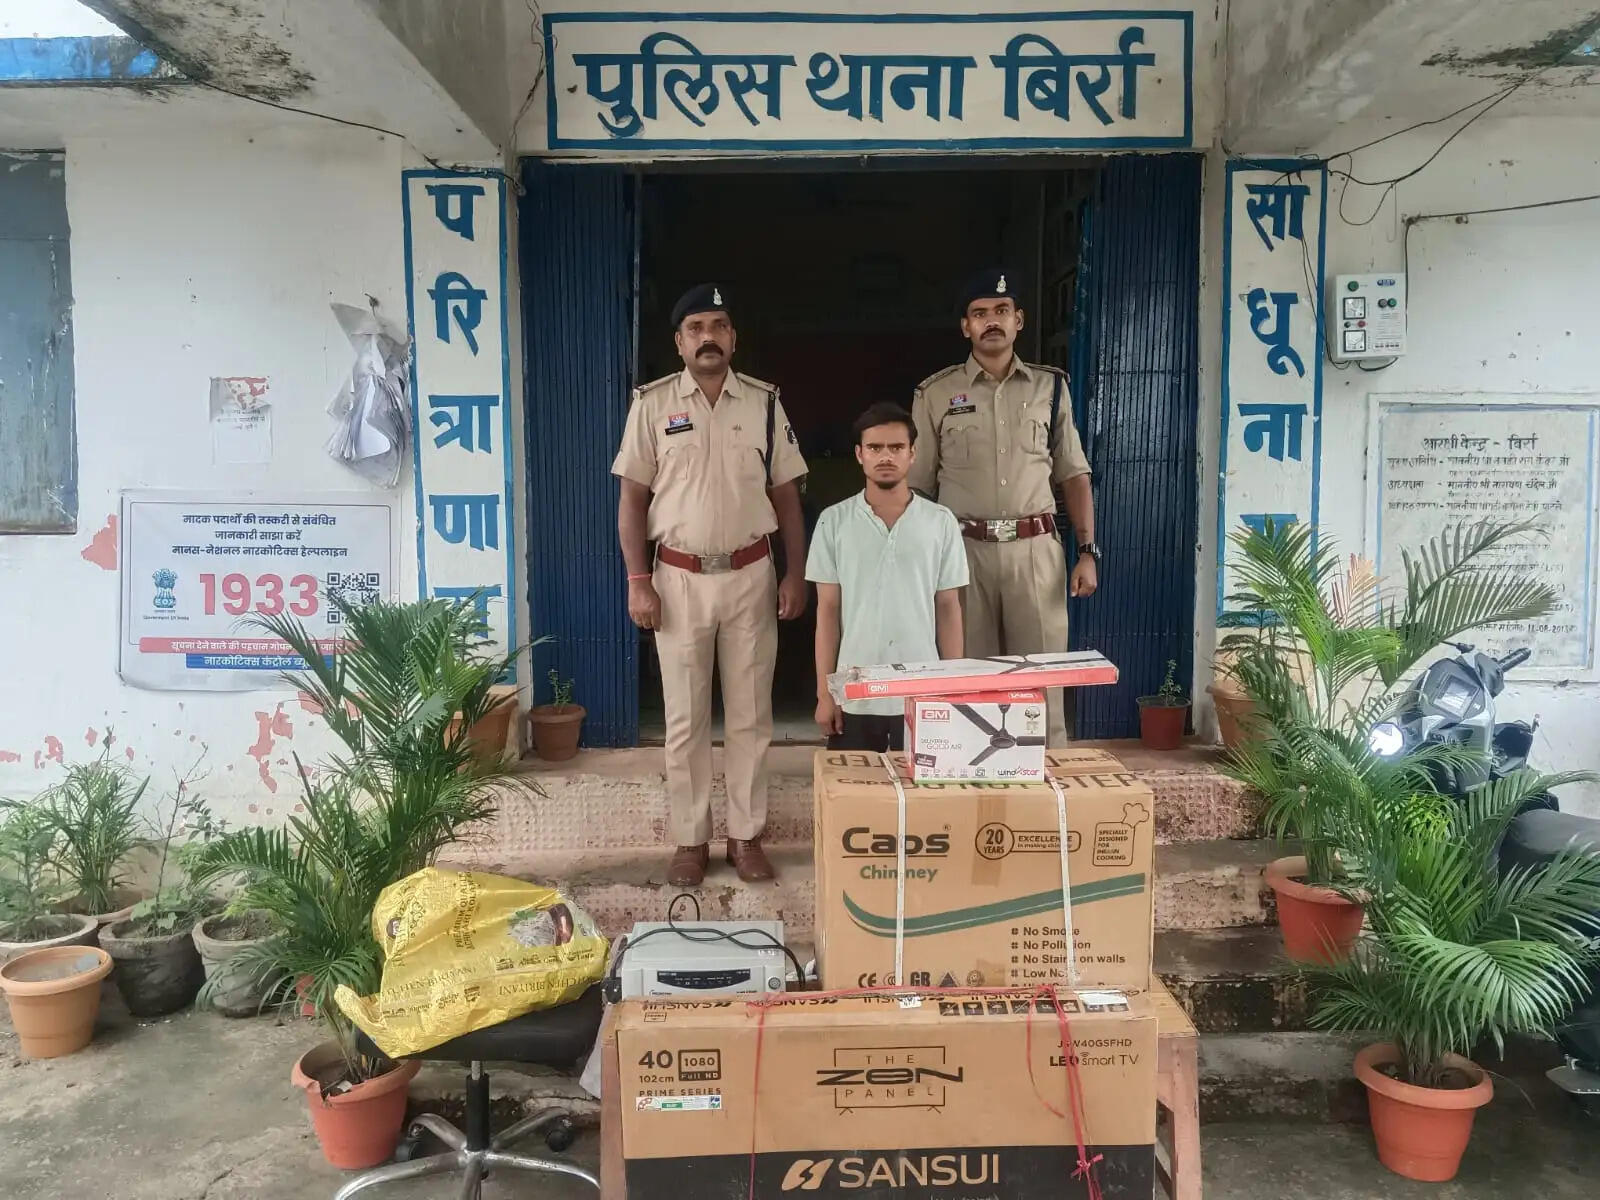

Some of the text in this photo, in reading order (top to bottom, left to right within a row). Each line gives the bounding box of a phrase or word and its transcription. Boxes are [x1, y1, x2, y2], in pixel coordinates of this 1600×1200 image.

[572, 26, 1155, 138] पुलिस थाना बिर्रा
[183, 514, 210, 524] मादक
[243, 513, 256, 524] की
[258, 514, 289, 525] तस्करी
[291, 514, 300, 525] से
[302, 514, 336, 526] संबंधित
[214, 529, 302, 541] जानकारी साझा करें
[172, 545, 348, 557] मानस-नेशनल नारकोटिक्स हेल्पलाइन
[200, 573, 319, 617] 1933
[171, 641, 195, 652] सूचना
[196, 640, 209, 650] देने
[210, 640, 226, 650] वाले
[228, 640, 241, 650] की
[204, 655, 260, 666] नारकोटिक्स
[262, 655, 291, 667] कंट्रोल
[924, 710, 948, 719] GM
[986, 829, 1004, 845] 20
[1018, 835, 1072, 843] EXCELLENE
[983, 846, 1005, 854] YEARS
[1023, 926, 1080, 936] No Smoe
[1023, 941, 1039, 950] No
[1023, 955, 1039, 964] No
[1079, 955, 1094, 963] on
[1097, 954, 1126, 964] walls
[1023, 968, 1047, 978] Low
[638, 1049, 673, 1069] 40
[684, 1057, 715, 1067] 1080
[865, 1054, 915, 1065] THE
[1081, 1054, 1115, 1066] smart
[1119, 1054, 1139, 1065] TV
[639, 1087, 721, 1097] PRIME SERIES
[844, 1087, 934, 1098] PANEL
[838, 1153, 1000, 1188] SANSUI
